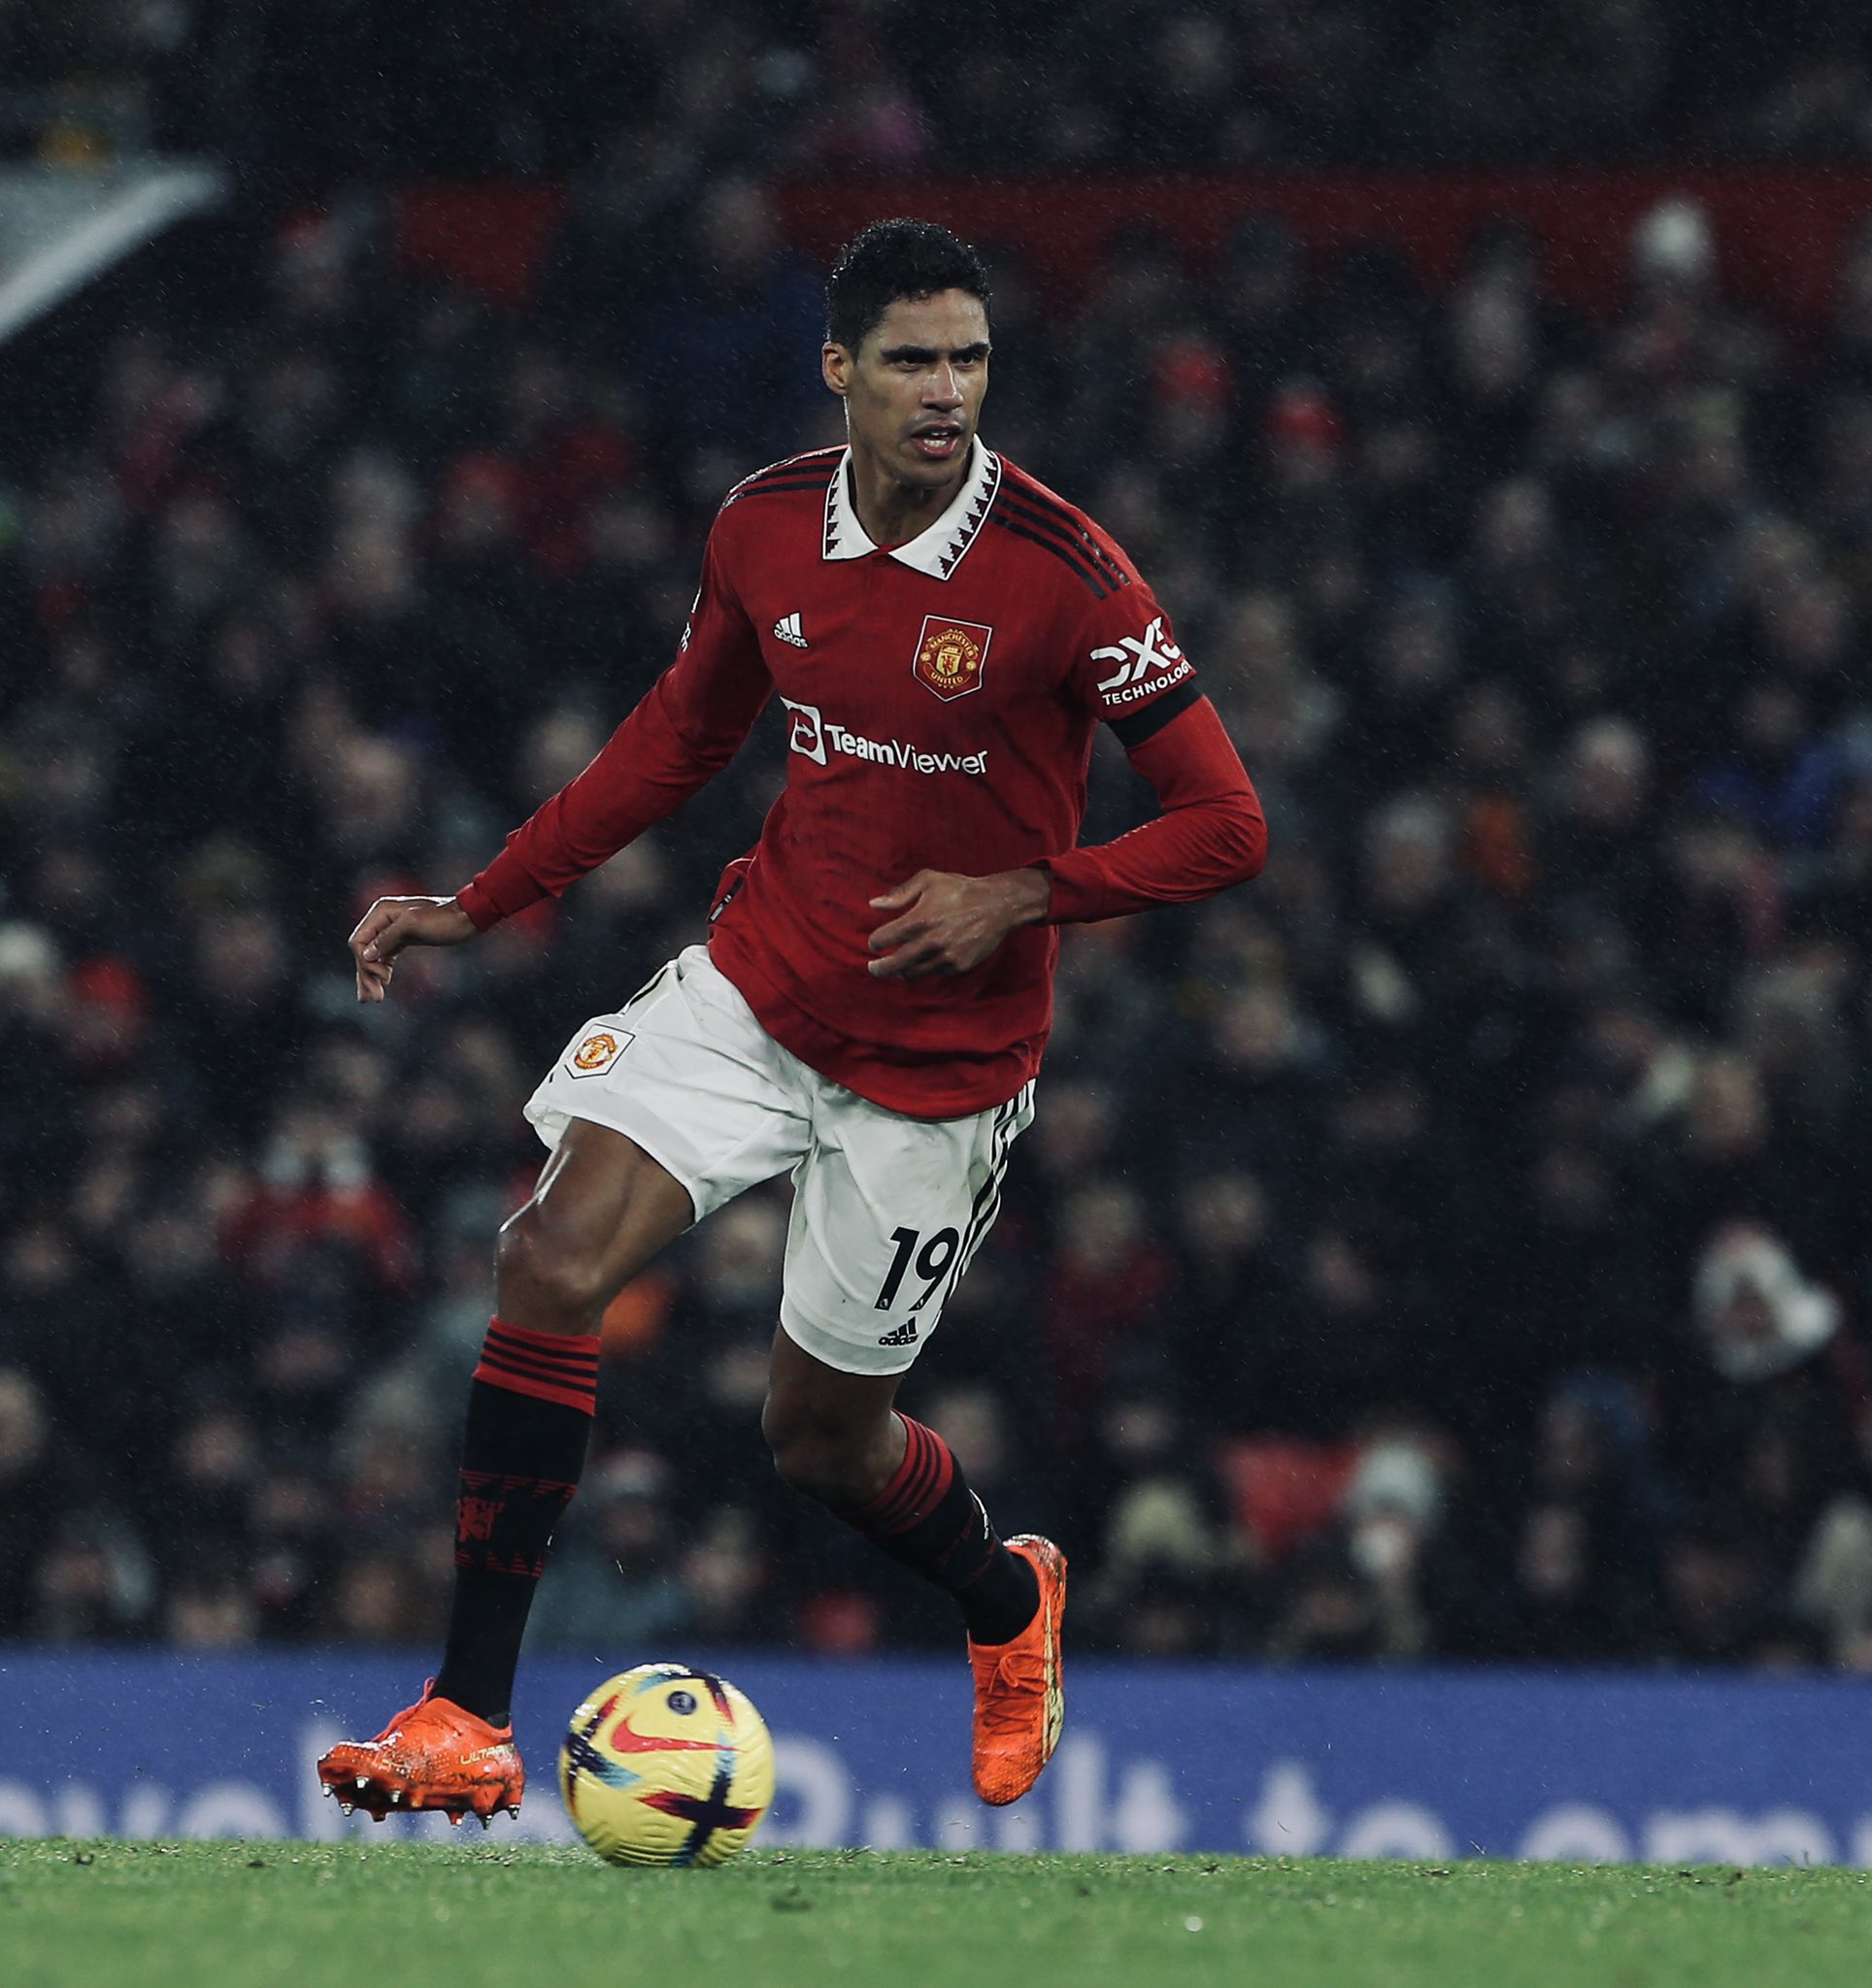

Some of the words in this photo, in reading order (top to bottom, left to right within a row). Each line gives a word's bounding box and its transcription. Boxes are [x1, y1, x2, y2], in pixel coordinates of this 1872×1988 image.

[929, 632, 976, 658] MANCHESTER
[930, 672, 963, 685] UNITED
[1102, 658, 1192, 706] TECHNOLOG
[823, 723, 988, 775] TeamViewer
[874, 1226, 960, 1312] 19
